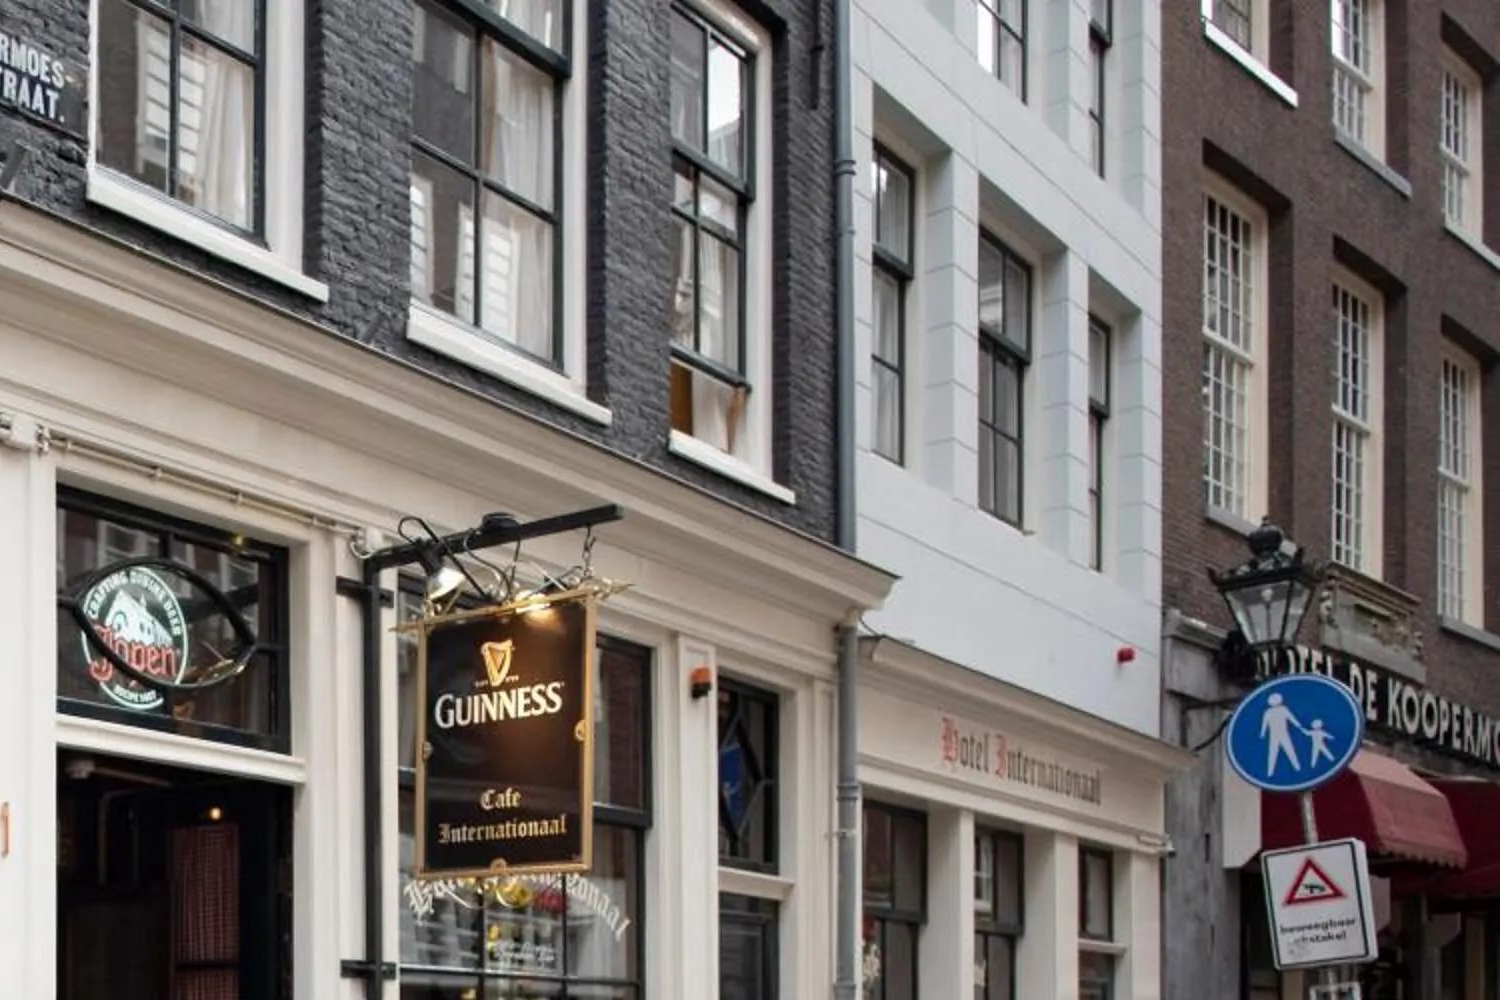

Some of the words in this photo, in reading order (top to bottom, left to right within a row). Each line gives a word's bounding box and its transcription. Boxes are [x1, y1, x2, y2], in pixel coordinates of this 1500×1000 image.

[434, 681, 563, 729] GUINNESS
[941, 716, 990, 774] Hotel
[480, 787, 521, 811] Cafe
[438, 813, 567, 844] Internationaal
